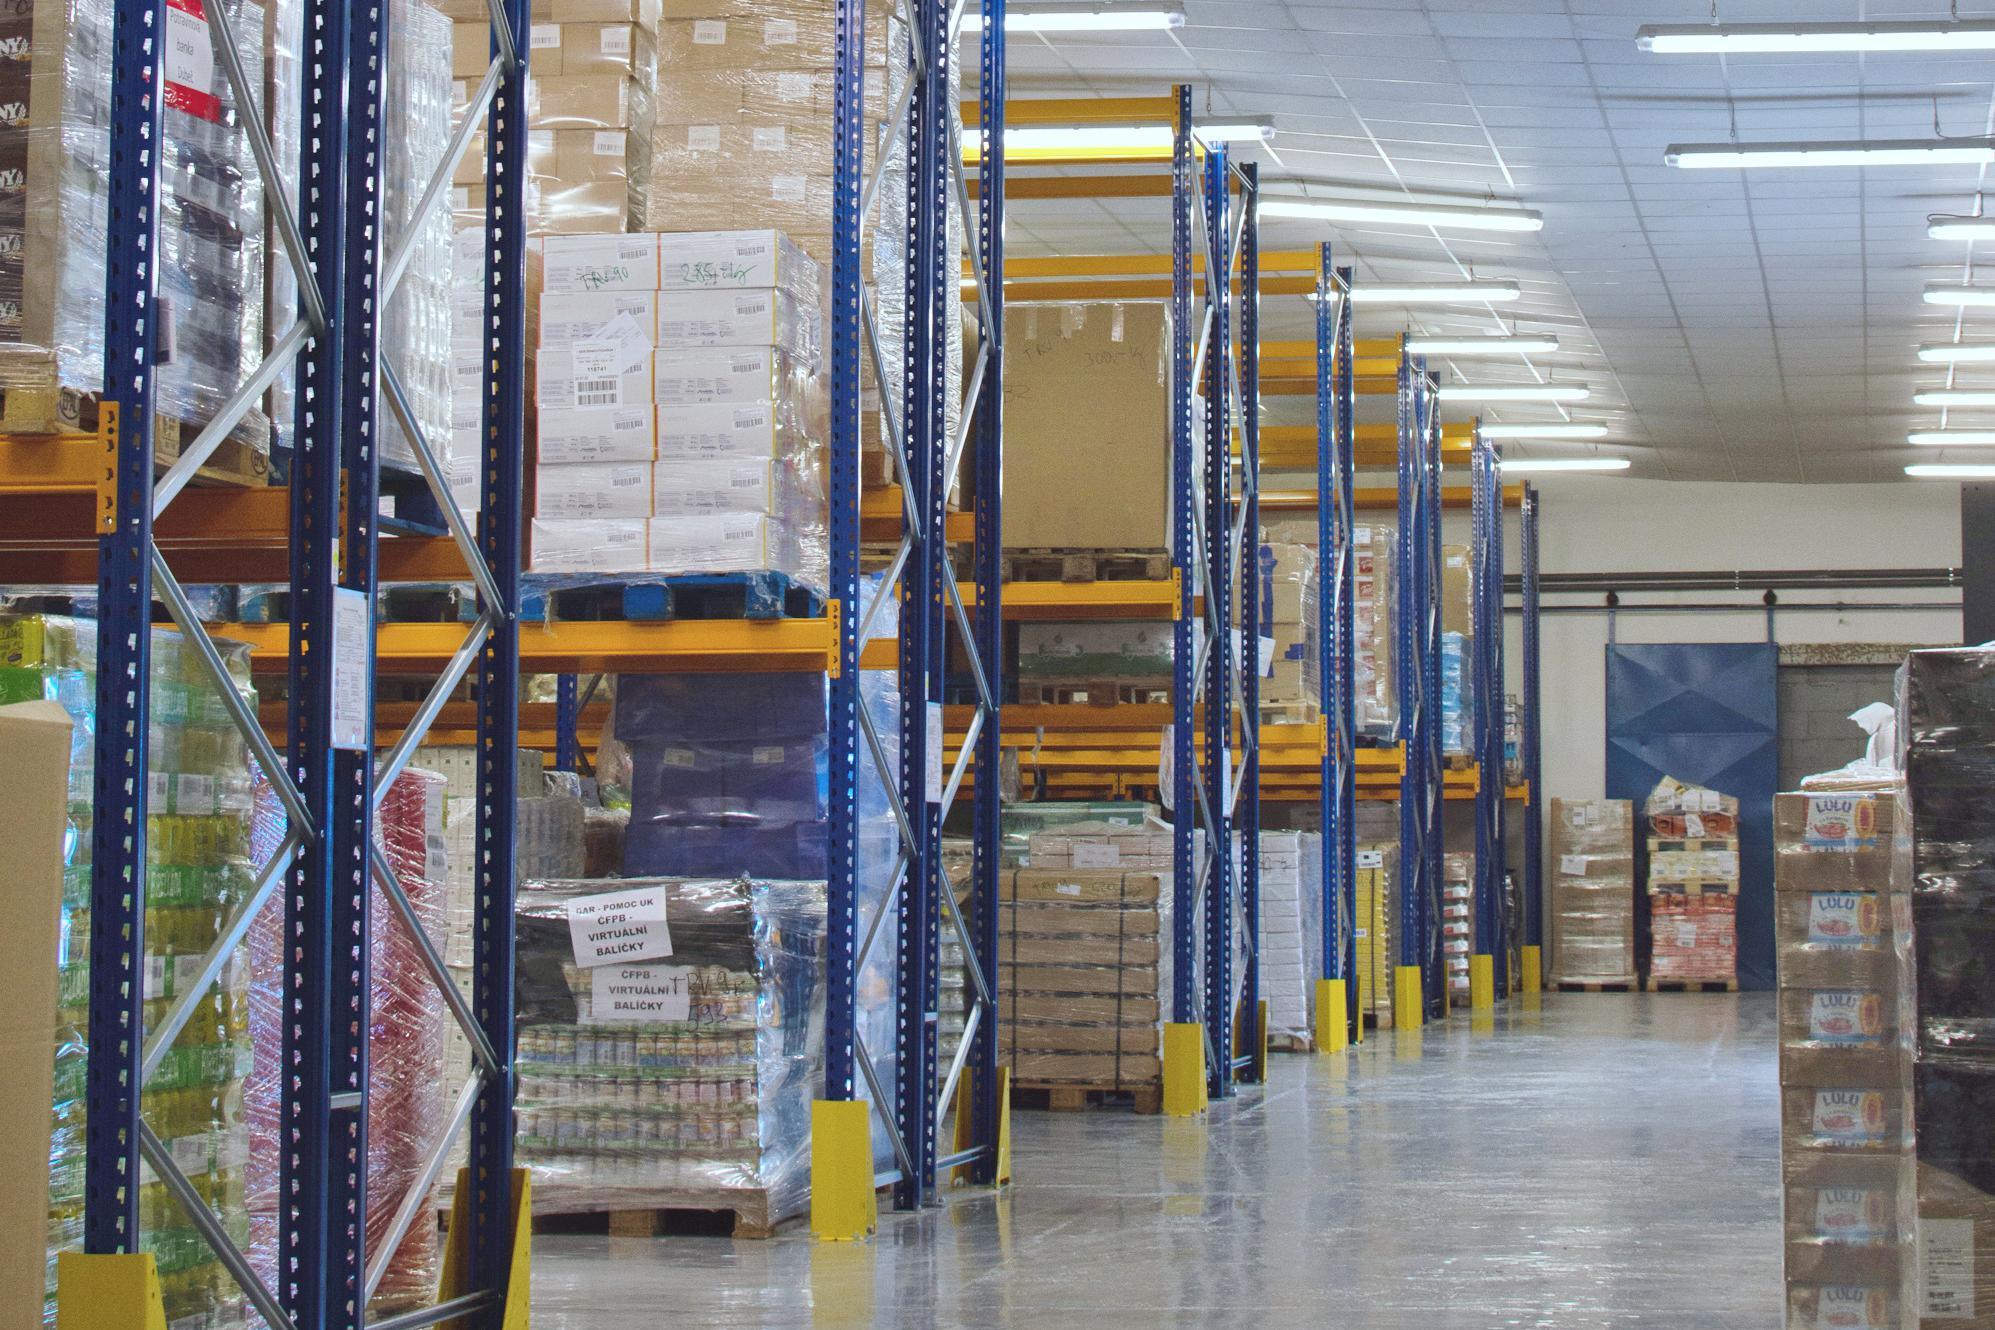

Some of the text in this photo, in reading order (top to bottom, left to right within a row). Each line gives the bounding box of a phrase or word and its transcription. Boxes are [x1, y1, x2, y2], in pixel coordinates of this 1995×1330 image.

[1816, 800, 1852, 813] LULU
[603, 901, 637, 912] POMOC
[640, 898, 654, 907] UK
[1819, 897, 1855, 910] LULU
[597, 914, 626, 925] ČFPB
[588, 925, 648, 942] VIRTUÁLNÍ
[596, 942, 645, 957] BALÍČKY
[621, 969, 650, 979] ČFPB
[609, 984, 669, 995] VIRTUÁLNÍ
[614, 999, 664, 1010] BALÍČKY
[1820, 994, 1856, 1009] LULU
[1822, 1093, 1859, 1106] LULU
[1825, 1190, 1861, 1204] LULU
[1827, 1286, 1863, 1302] LULU
